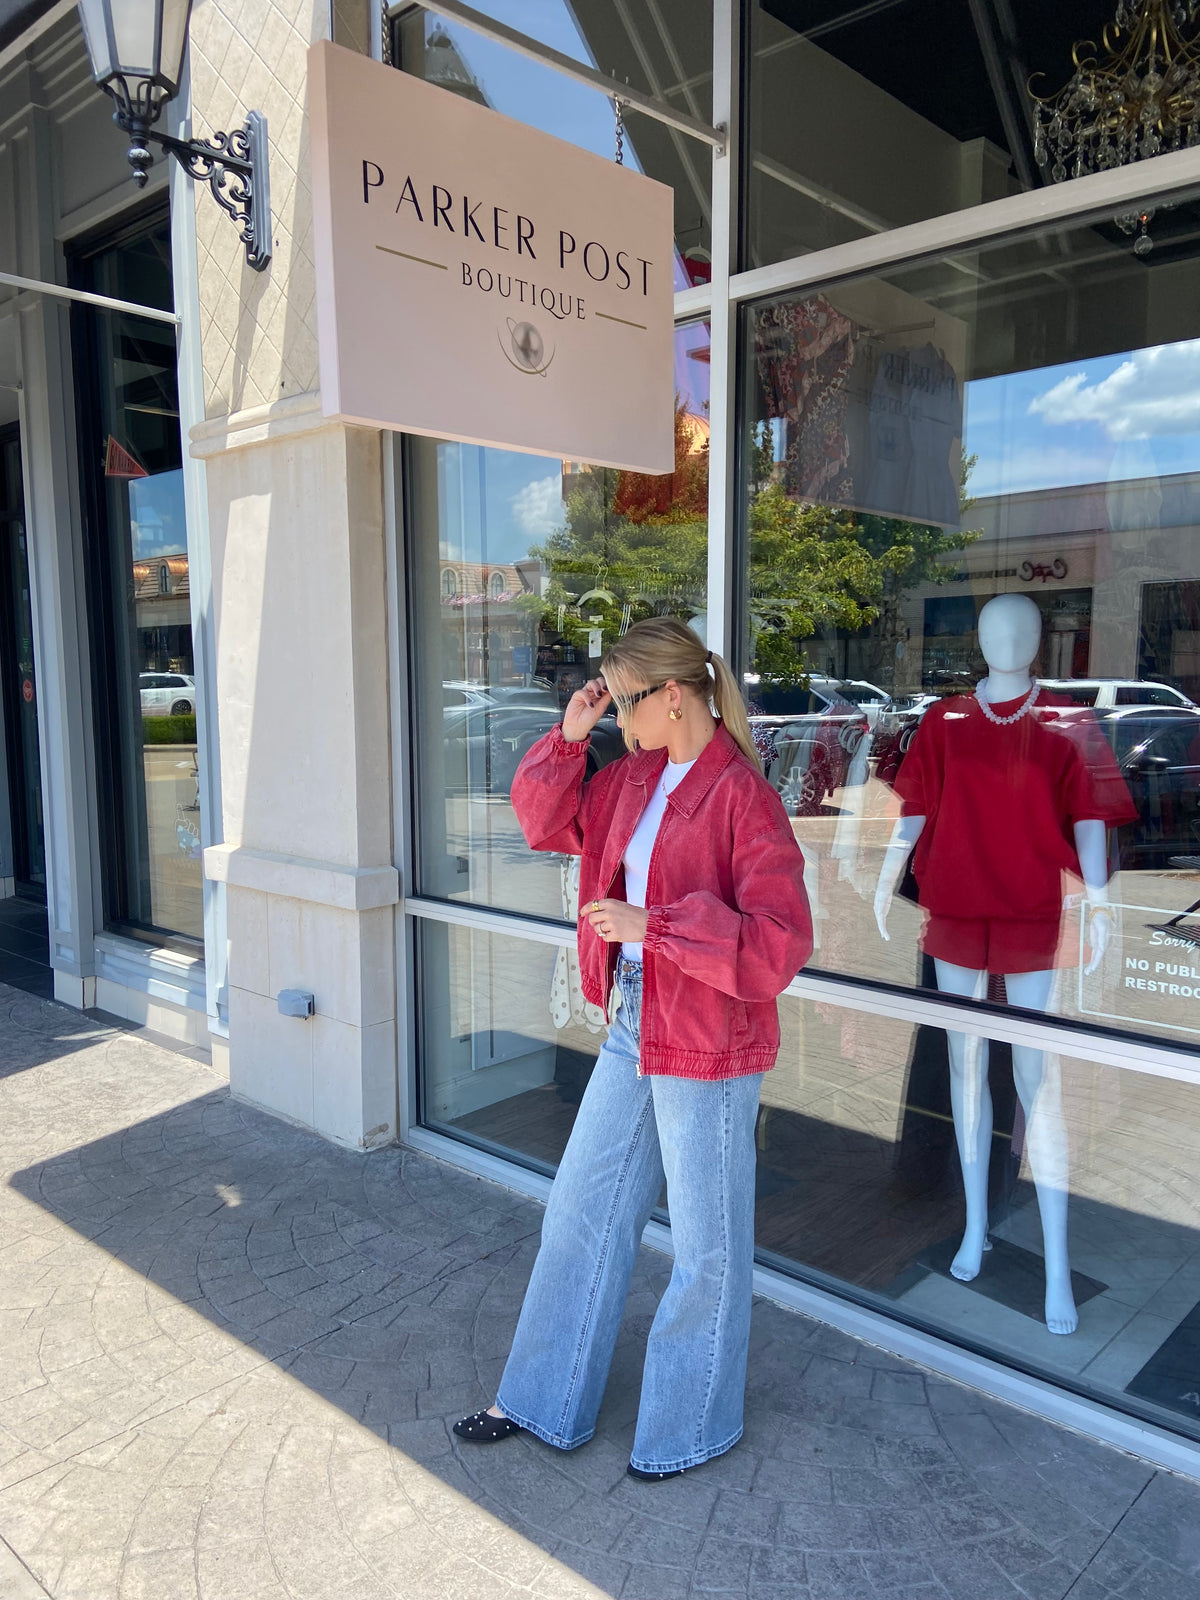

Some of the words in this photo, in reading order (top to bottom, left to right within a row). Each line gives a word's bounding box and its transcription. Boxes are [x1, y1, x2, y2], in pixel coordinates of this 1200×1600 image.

[363, 159, 537, 259] PARKER
[559, 230, 653, 295] POST
[461, 262, 586, 320] BOUTIQUE
[1148, 931, 1196, 953] Sorry
[1125, 957, 1150, 971] NO
